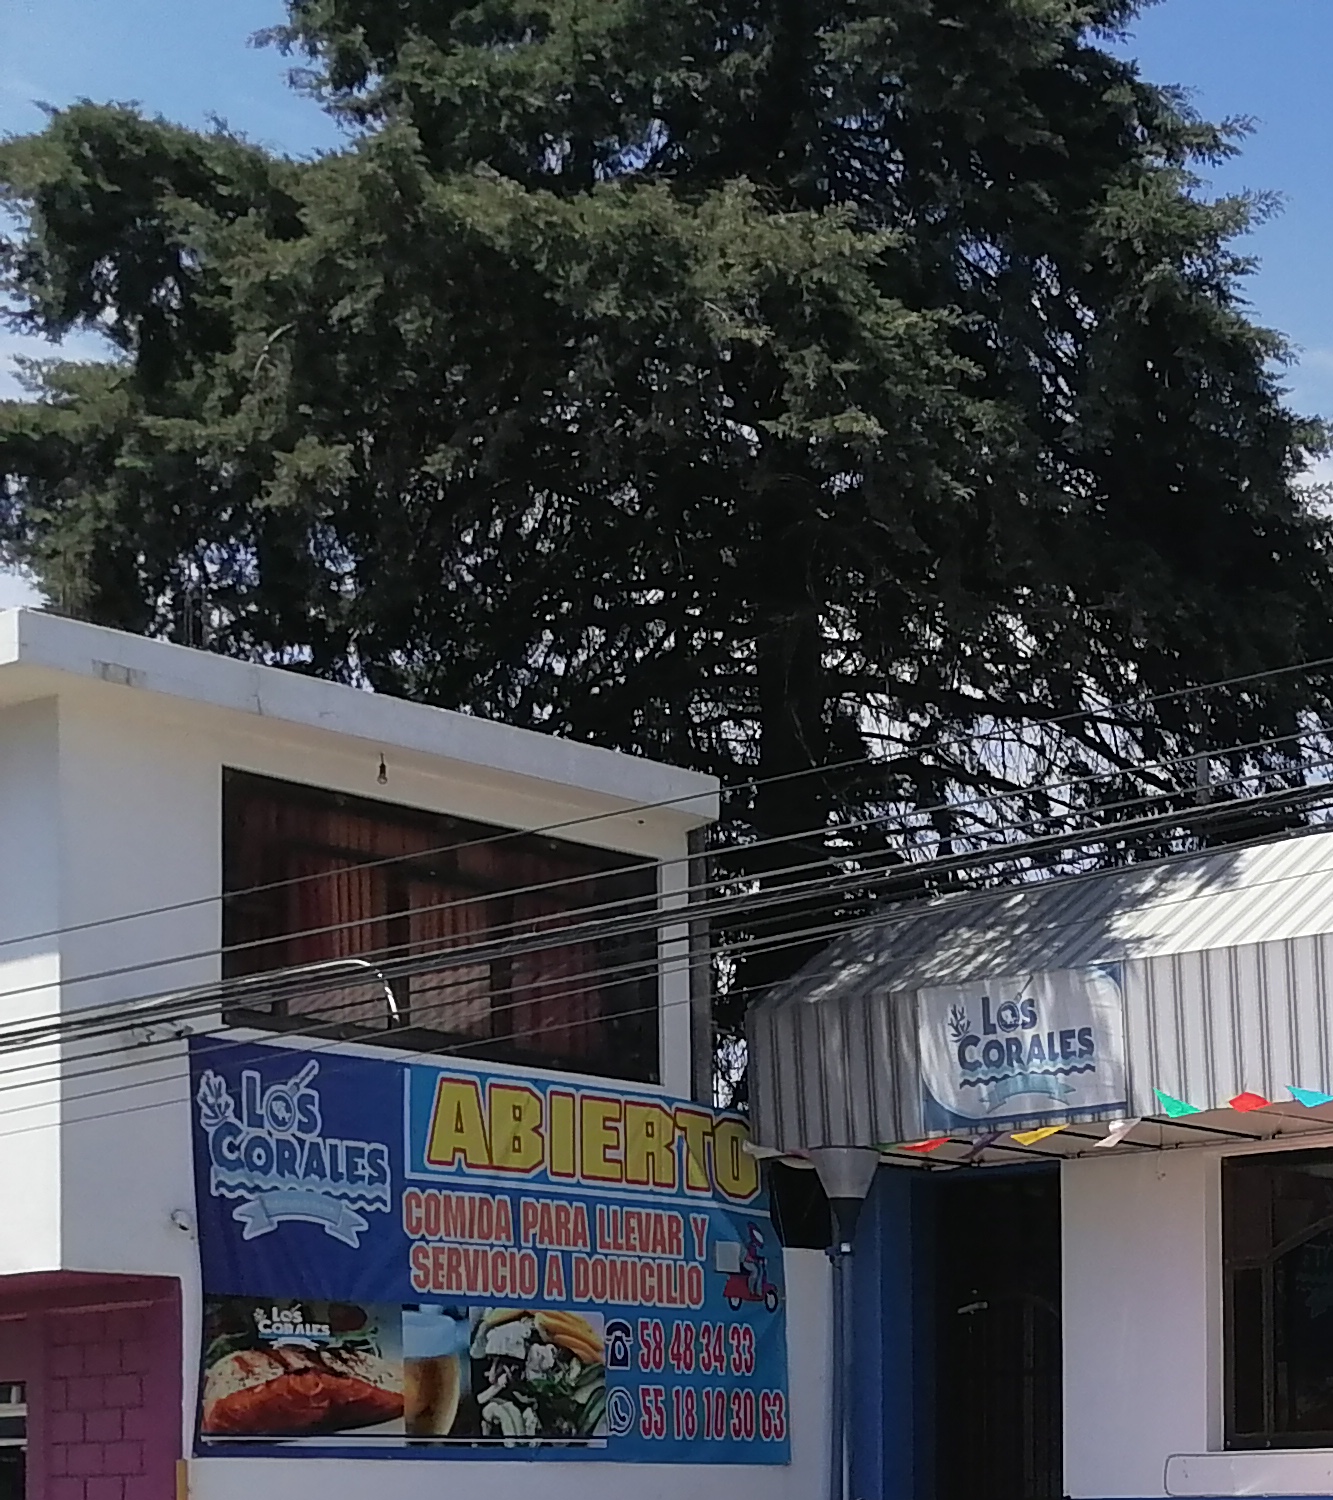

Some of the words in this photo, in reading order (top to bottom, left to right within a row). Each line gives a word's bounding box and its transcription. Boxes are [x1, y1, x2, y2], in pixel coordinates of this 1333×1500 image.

[981, 997, 1038, 1034] LOS
[957, 1027, 1095, 1070] CORALES
[243, 1071, 321, 1137] LOS
[210, 1120, 389, 1186] CORALES
[426, 1074, 760, 1201] ABIERTO
[404, 1189, 512, 1244] COMIDA
[521, 1199, 589, 1249] PARA
[598, 1205, 683, 1256] LLEVAR
[691, 1214, 709, 1259] Y
[411, 1243, 537, 1295] SERVICIO
[546, 1252, 565, 1299] A
[573, 1256, 704, 1306] DOMICILIO
[639, 1319, 664, 1371] 58
[671, 1322, 694, 1372] 48
[701, 1323, 725, 1374] 34
[731, 1325, 754, 1375] 33
[640, 1386, 665, 1438] 55
[673, 1388, 696, 1439] 18
[704, 1388, 725, 1439] 10
[732, 1390, 754, 1440] 30
[761, 1391, 785, 1440] 63
